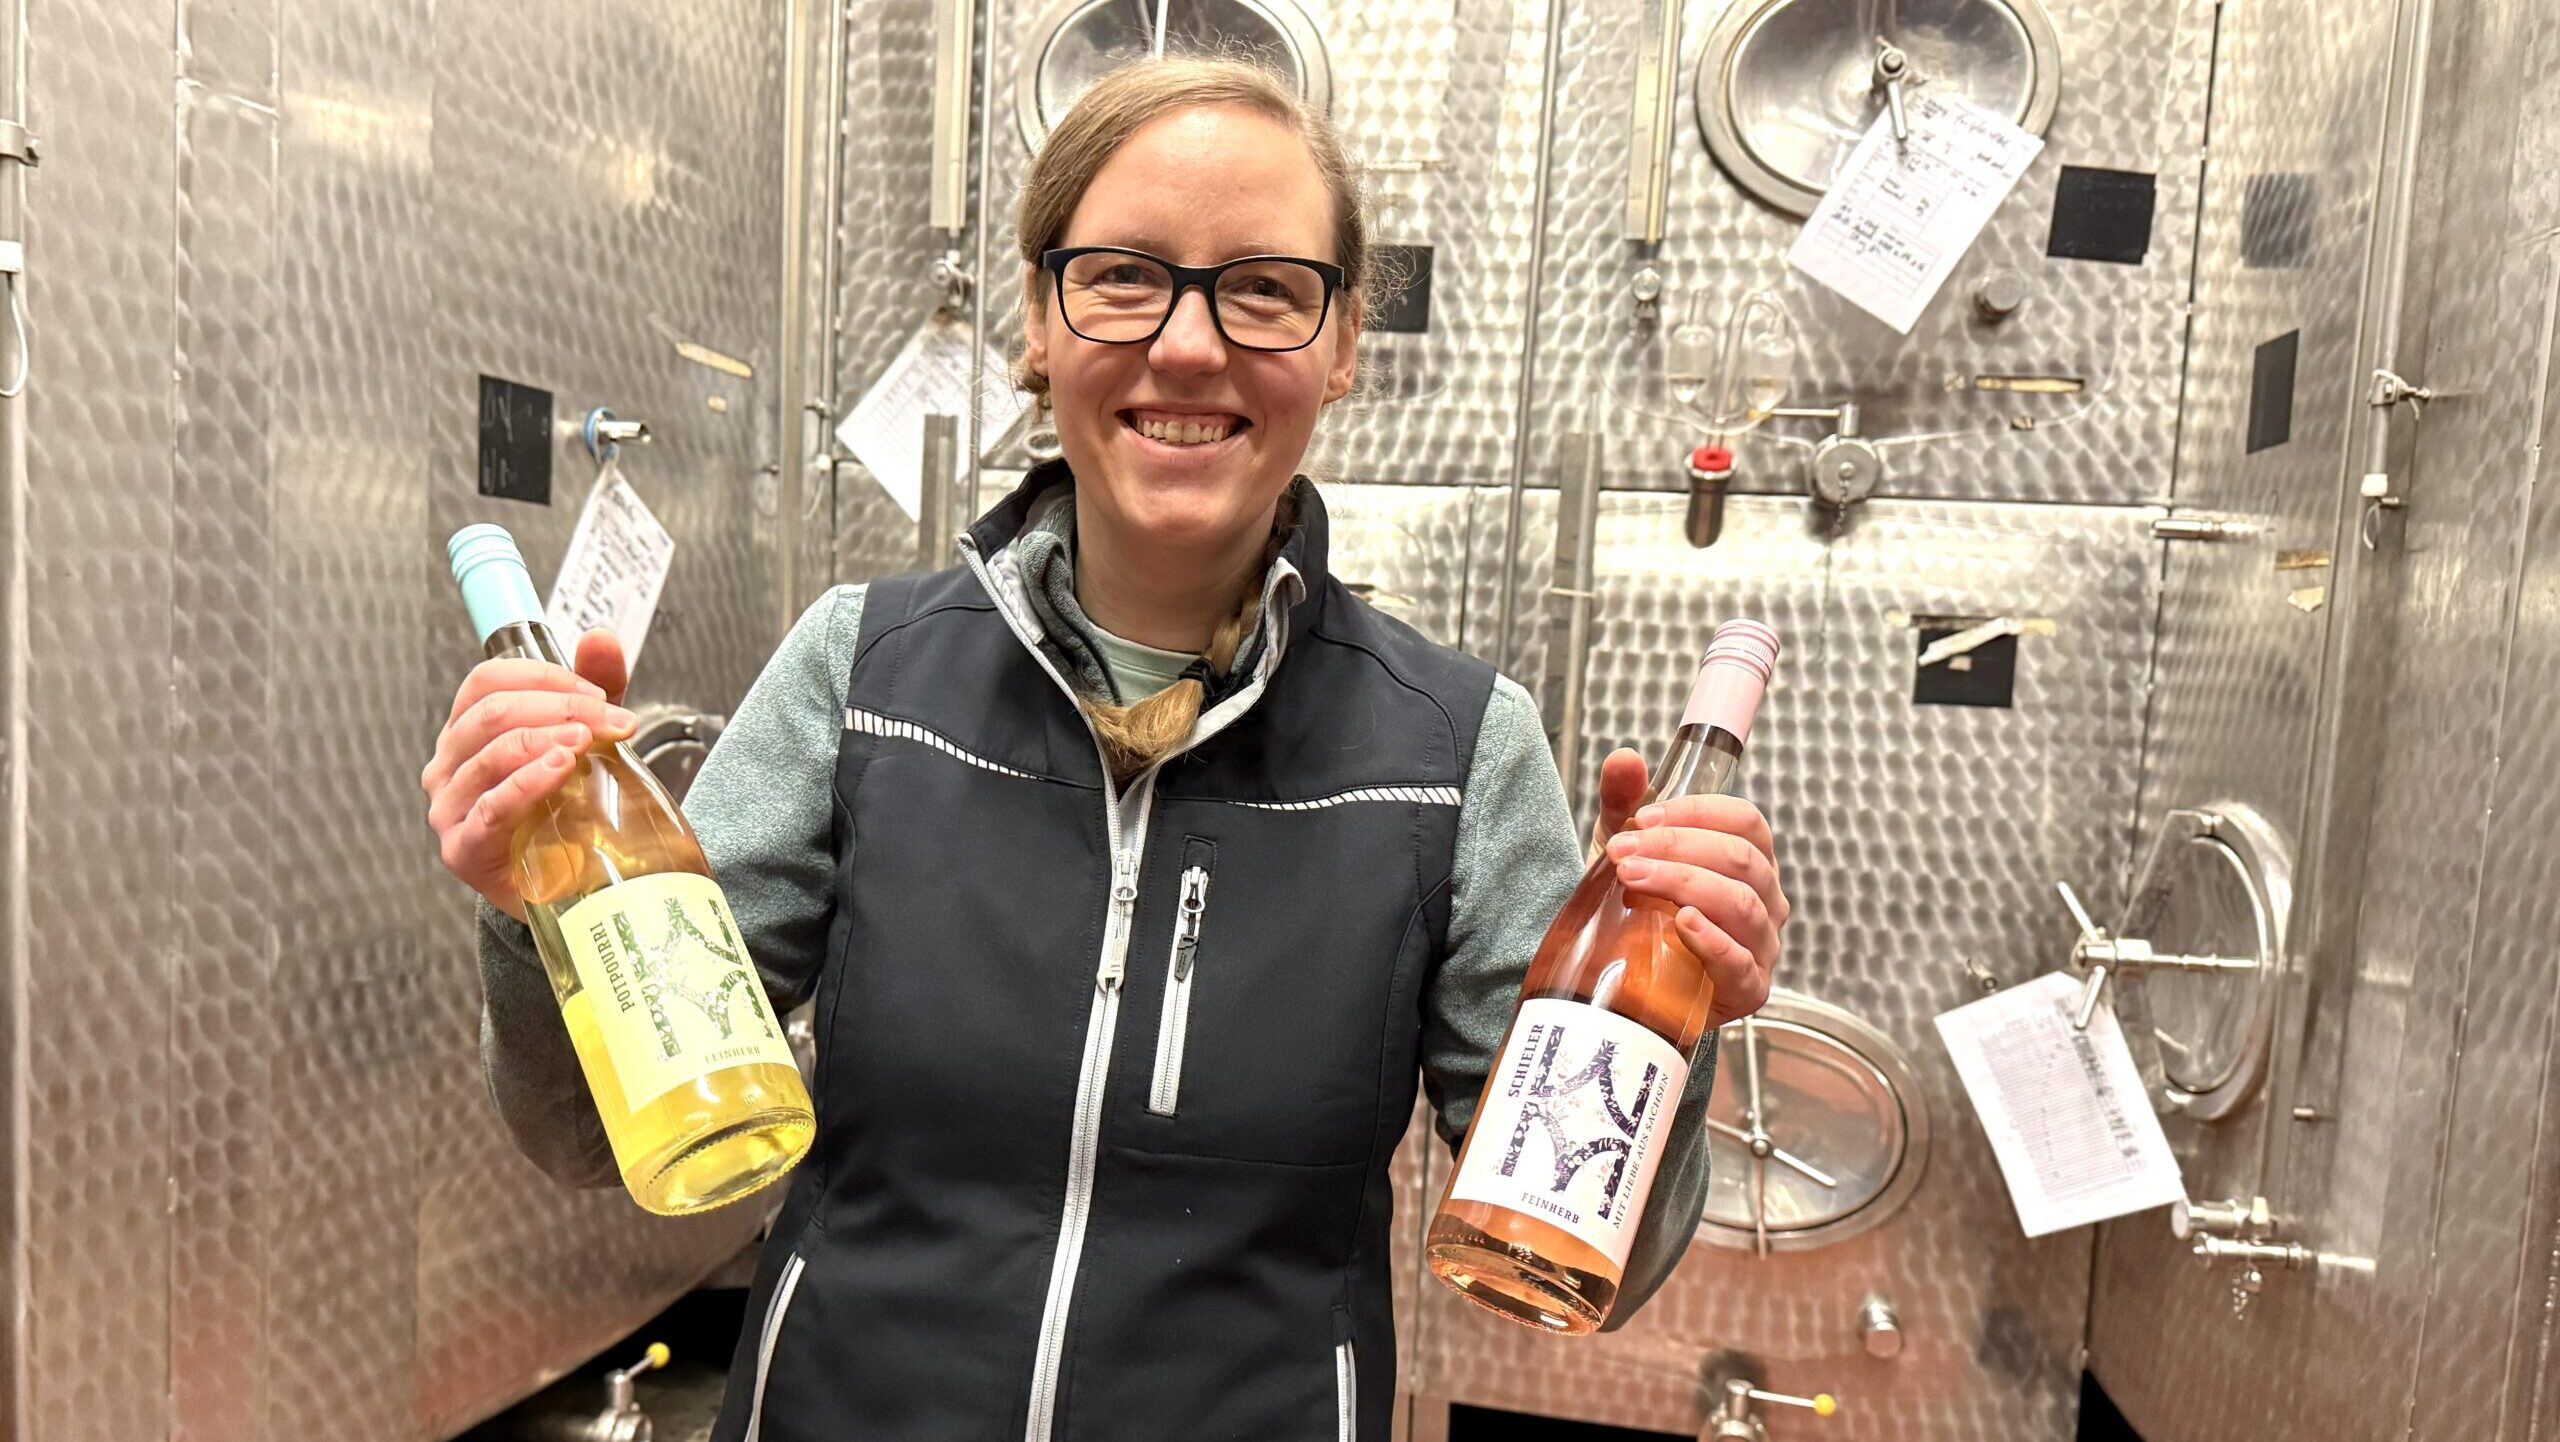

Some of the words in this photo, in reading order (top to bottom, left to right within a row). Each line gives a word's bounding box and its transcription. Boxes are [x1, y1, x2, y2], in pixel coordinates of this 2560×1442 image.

[590, 921, 635, 1013] POTPOURRI
[1508, 1024, 1544, 1097] SCHIELER
[1613, 1202, 1627, 1229] MIT
[1622, 1162, 1640, 1199] LIEBE
[1637, 1134, 1649, 1160] AUS
[1645, 1073, 1669, 1132] SACHSEN
[1521, 1192, 1580, 1224] FEINHERB
